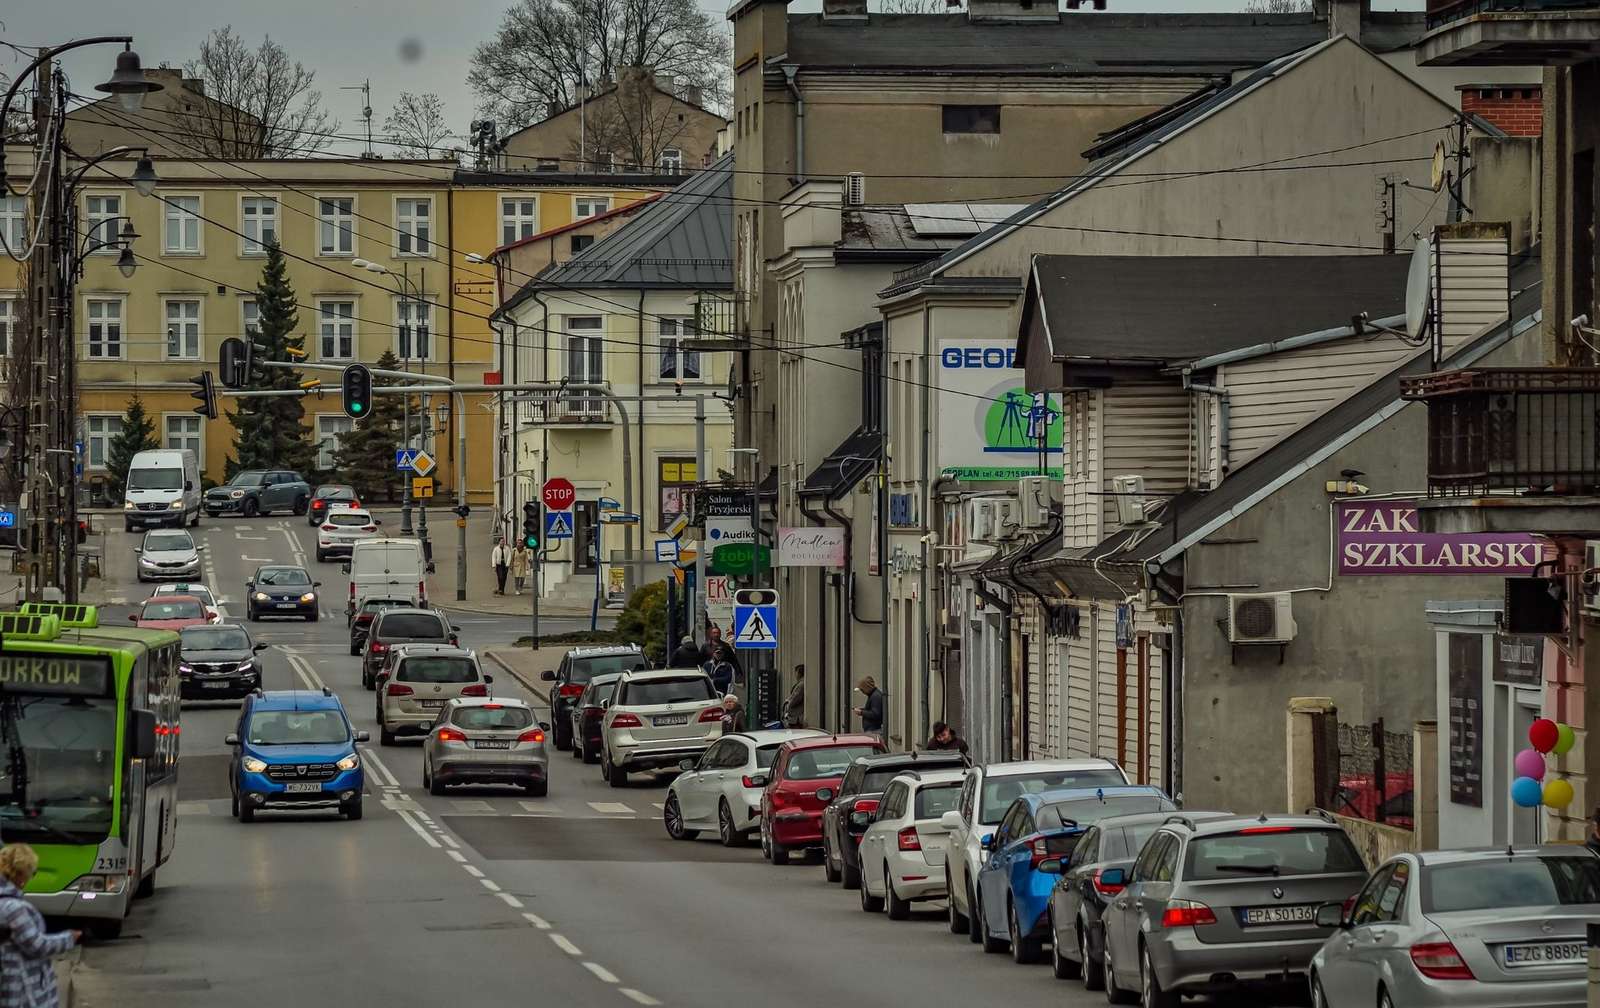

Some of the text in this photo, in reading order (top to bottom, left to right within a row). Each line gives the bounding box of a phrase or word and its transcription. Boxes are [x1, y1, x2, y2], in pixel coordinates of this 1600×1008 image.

[545, 489, 573, 499] STOP
[708, 495, 732, 504] Salon
[708, 504, 752, 515] Fryzjerski
[1343, 543, 1544, 567] SZKLARSKI
[1248, 906, 1311, 923] EPA 50136
[1514, 947, 1542, 962] EZG
